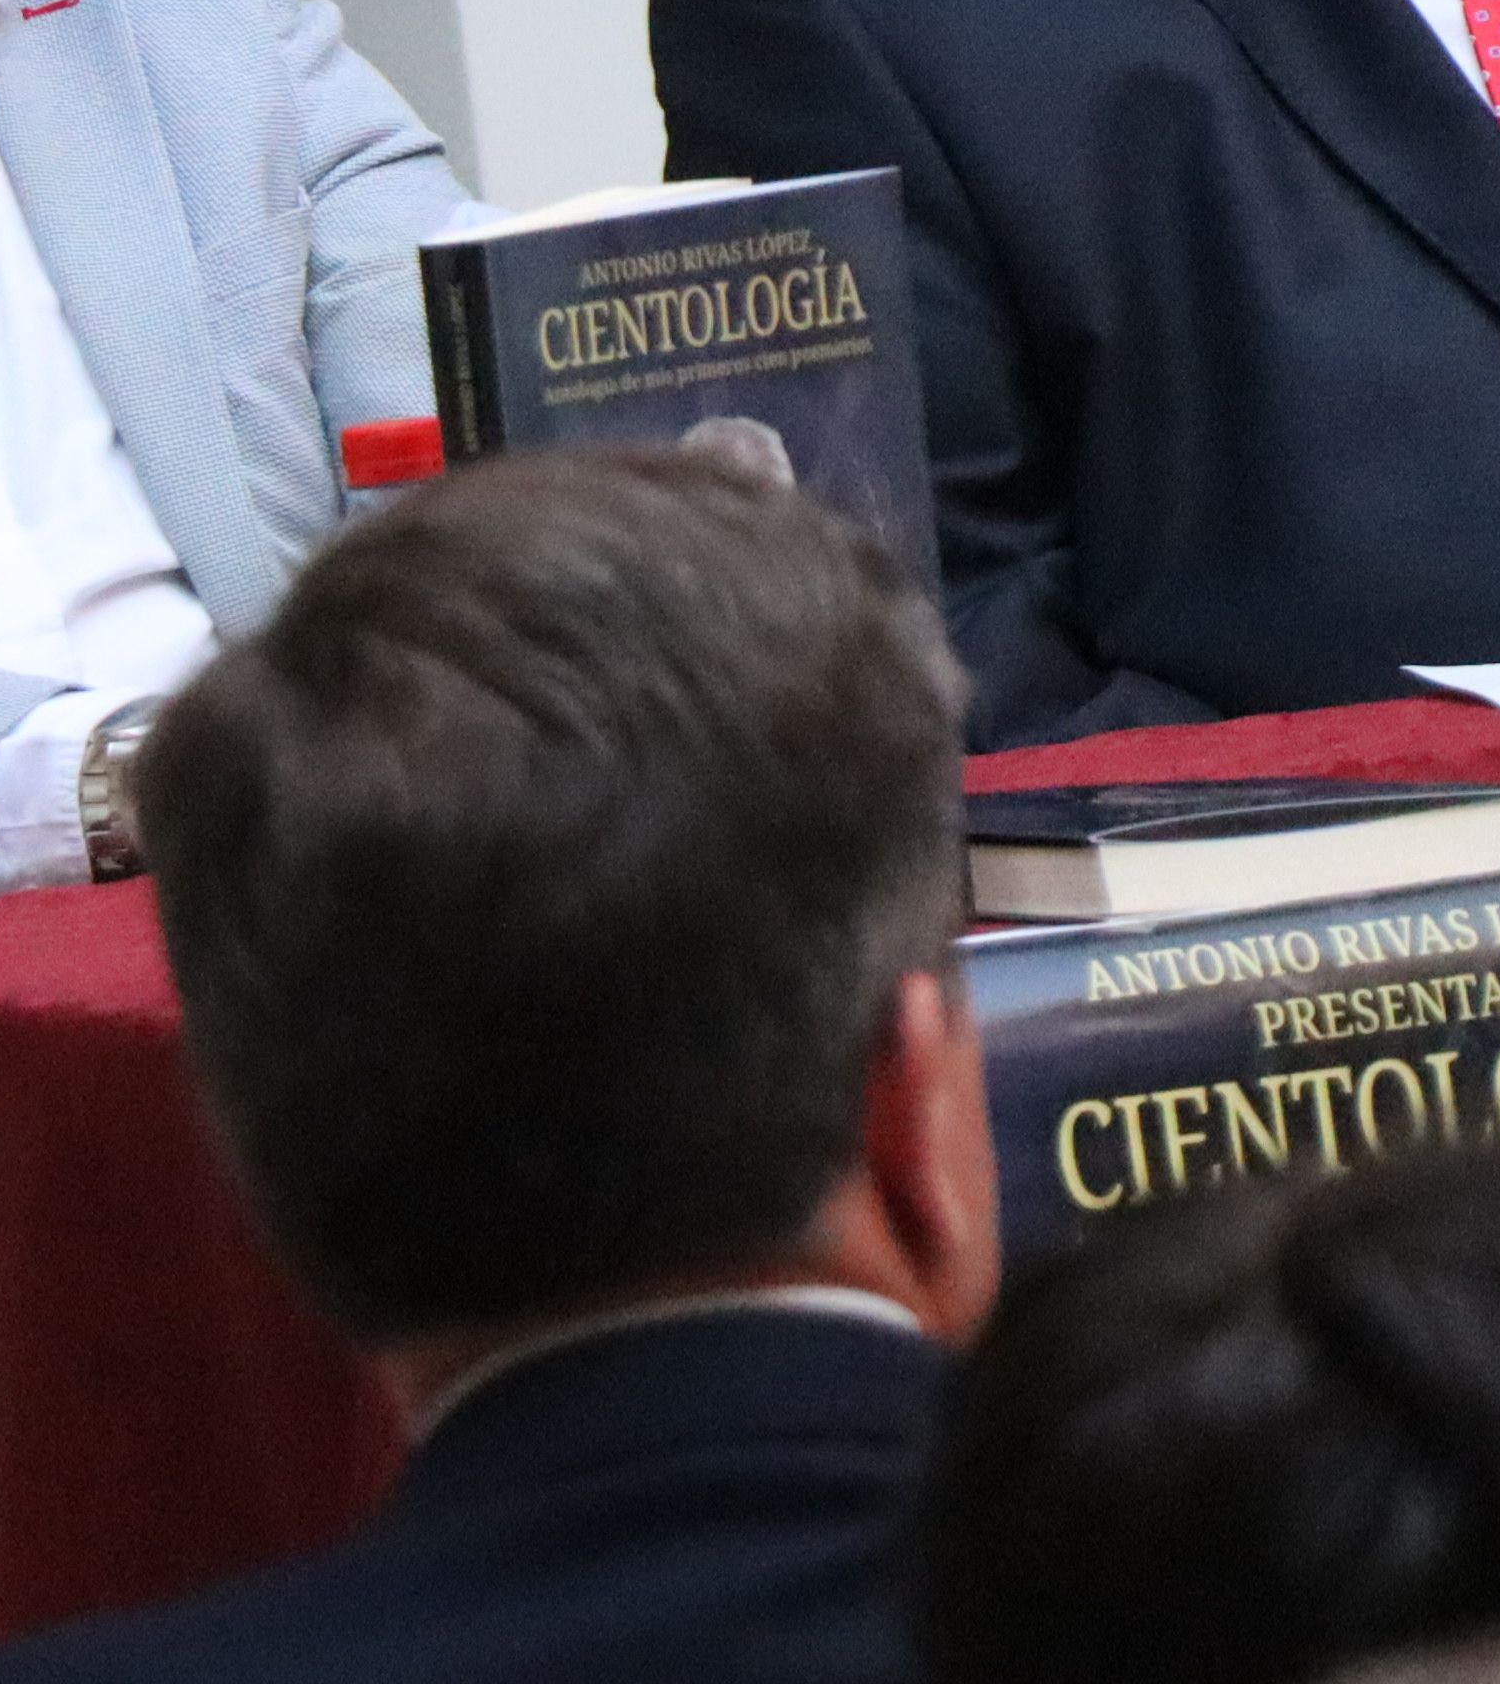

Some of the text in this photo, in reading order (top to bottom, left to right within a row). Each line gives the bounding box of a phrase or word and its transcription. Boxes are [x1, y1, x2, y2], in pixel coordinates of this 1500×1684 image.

[580, 228, 812, 288] ANTONIO RIVAS LÓPEZ
[540, 247, 867, 371] CIENTOLOGÍA
[1087, 930, 1320, 1002] ANTONIO
[1328, 909, 1479, 968] RIVAS
